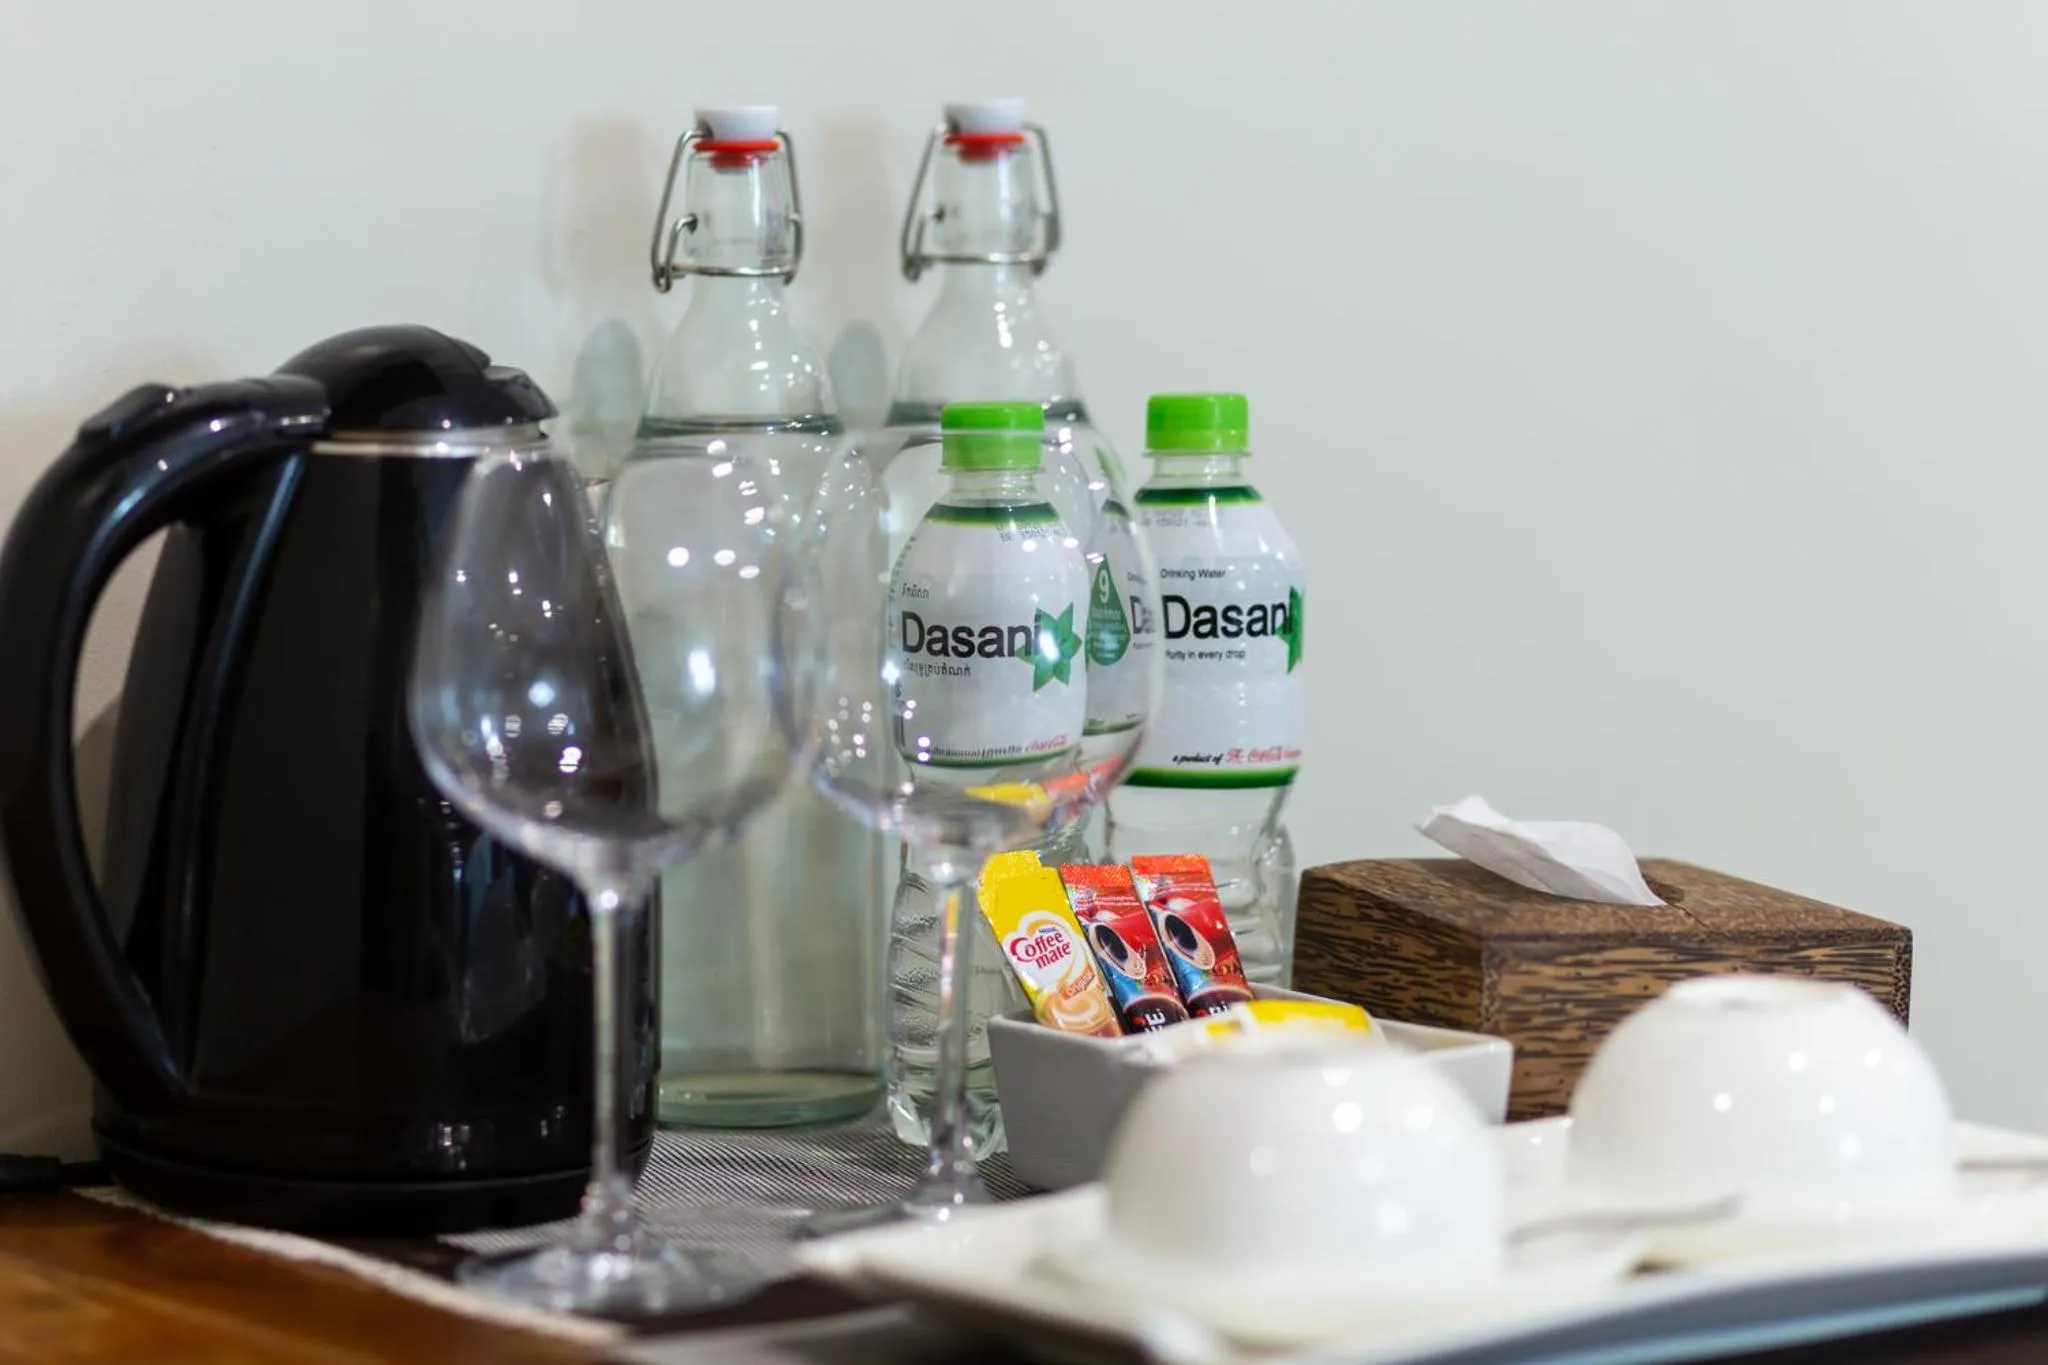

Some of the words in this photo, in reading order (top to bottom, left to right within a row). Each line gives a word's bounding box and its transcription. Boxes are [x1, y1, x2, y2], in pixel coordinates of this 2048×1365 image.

[1160, 568, 1195, 581] Drinking
[1198, 568, 1226, 578] Water
[902, 609, 1042, 659] Dasani
[1188, 650, 1195, 658] in
[1198, 650, 1223, 660] every
[1226, 649, 1246, 660] drop
[1010, 931, 1063, 962] Coffee
[1035, 942, 1072, 968] mate
